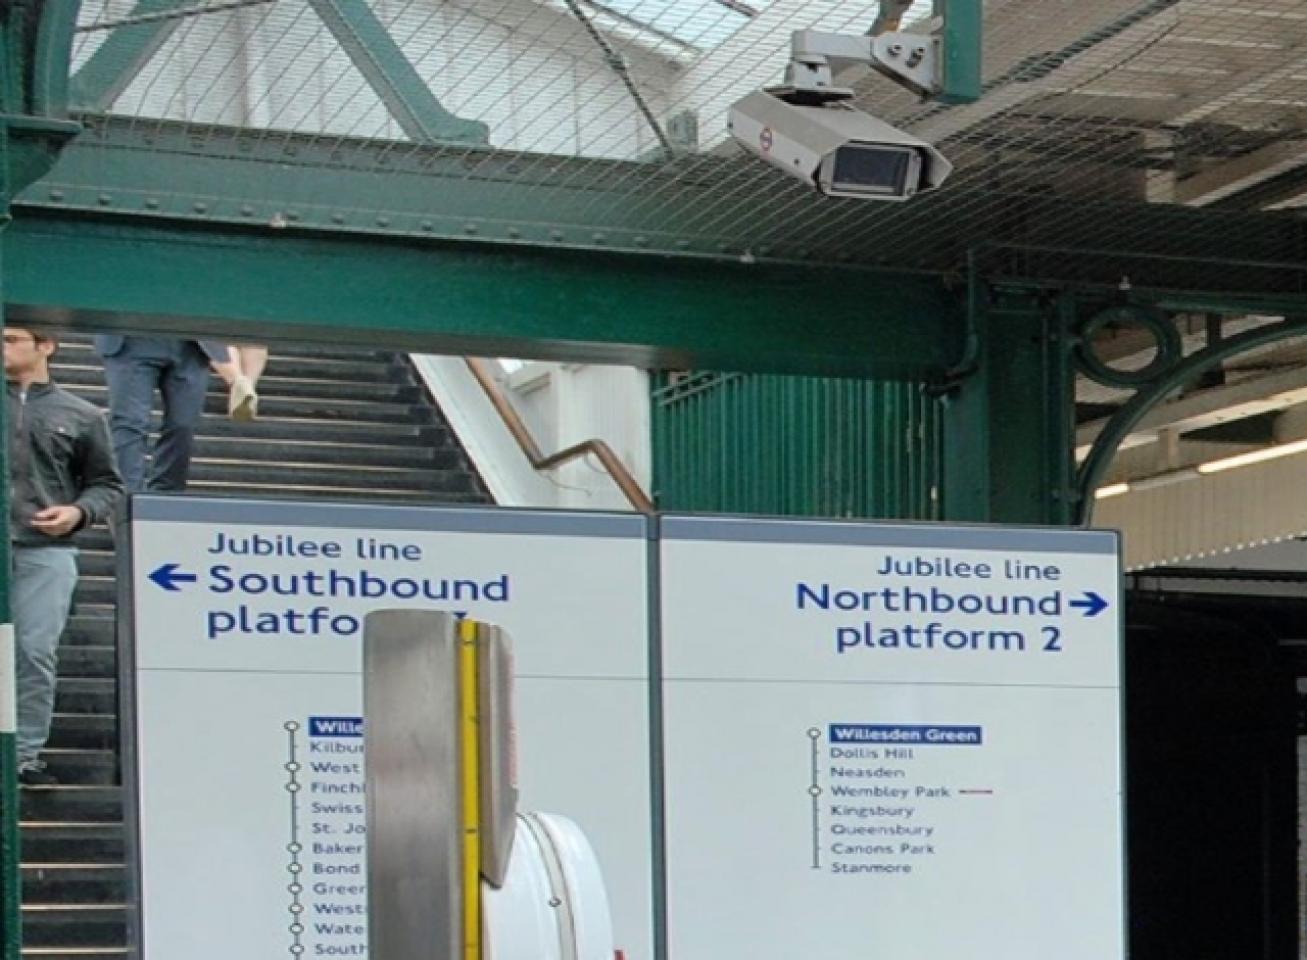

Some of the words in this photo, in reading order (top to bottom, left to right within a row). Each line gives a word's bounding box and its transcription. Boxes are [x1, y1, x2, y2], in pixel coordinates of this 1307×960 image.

[208, 533, 341, 557] Jubilee
[357, 538, 422, 560] line
[877, 556, 992, 579] Jubilee
[1004, 559, 1061, 580] line
[209, 566, 510, 601] Southbound
[796, 583, 1062, 616] Northbound
[836, 622, 1025, 653] platform
[1040, 626, 1062, 651] 2
[834, 728, 921, 741] Willesden
[925, 729, 977, 742] Green
[830, 747, 878, 759] Dollis
[884, 747, 914, 759] Hill
[310, 761, 361, 774] West
[830, 767, 905, 778] Neasden
[831, 786, 909, 799] Wembley
[915, 786, 950, 798] Park
[312, 801, 364, 813] Swiss
[830, 805, 915, 818] Kingsbury
[831, 824, 934, 838] Queensbury
[312, 842, 364, 854] Baker
[831, 843, 894, 855] Canons
[900, 843, 935, 855] Park
[313, 862, 360, 874] Bond
[831, 861, 911, 874] Stanmore
[313, 902, 368, 914] West
